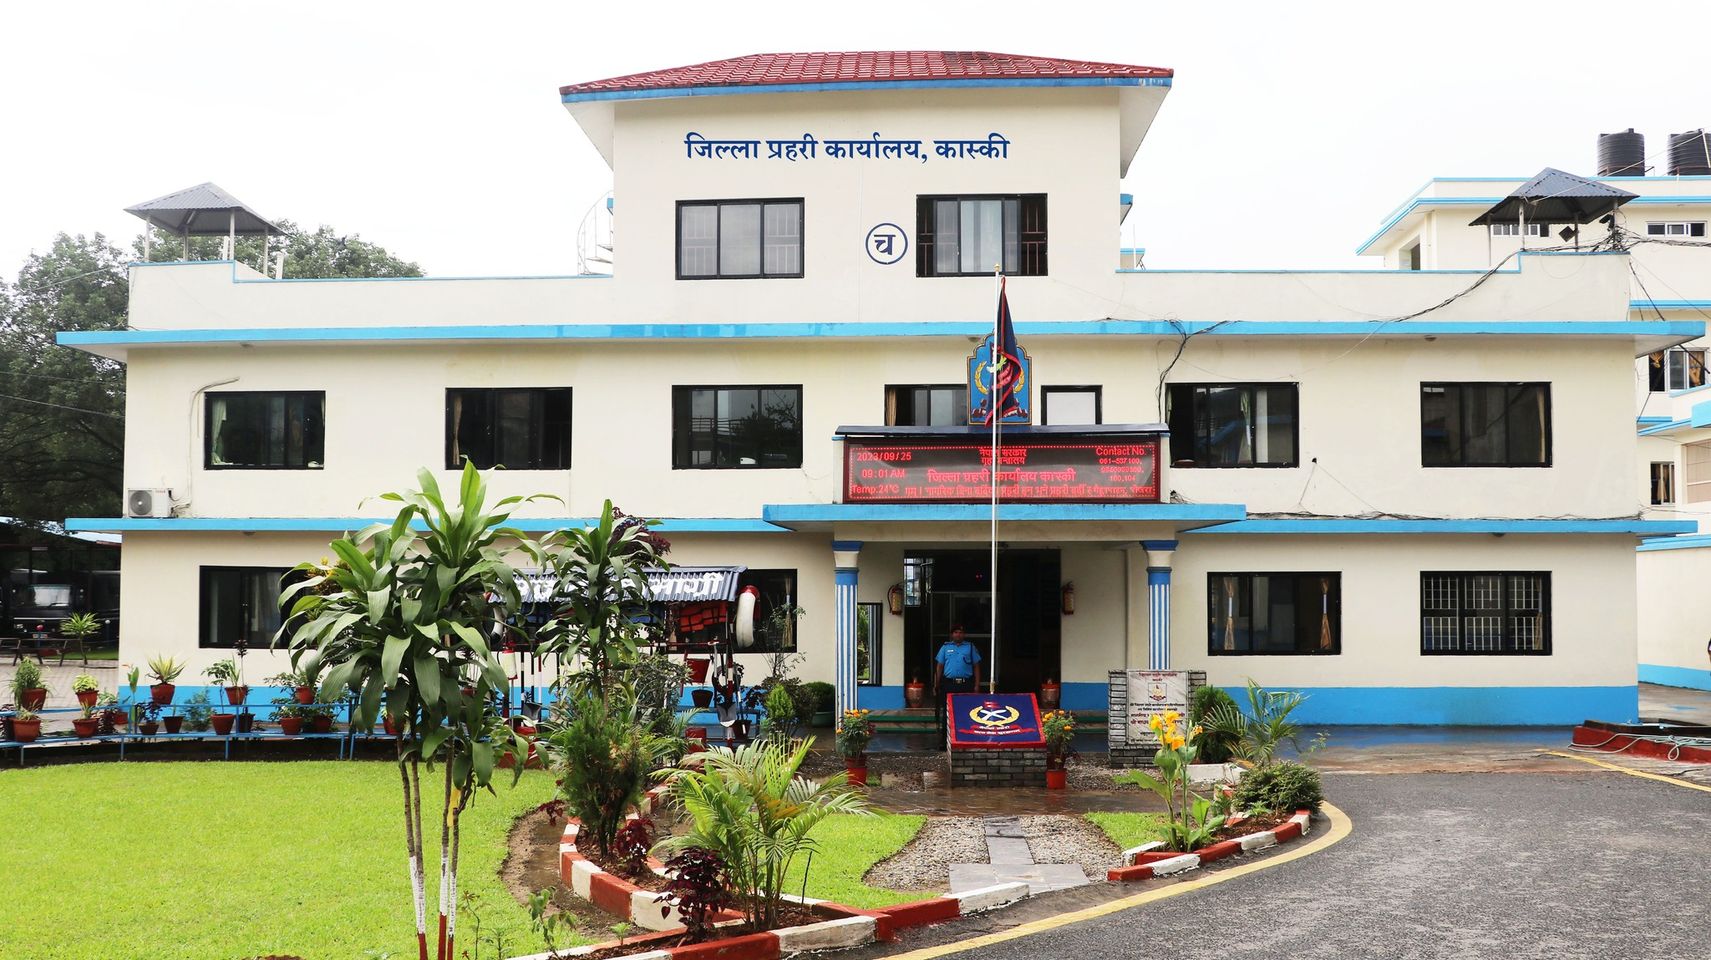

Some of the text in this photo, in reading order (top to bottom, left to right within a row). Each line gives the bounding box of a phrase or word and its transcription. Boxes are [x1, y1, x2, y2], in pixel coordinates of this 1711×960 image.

[684, 131, 1010, 164] जिल्ला प्रहरी कार्यालय, कास्की
[857, 451, 912, 461] 2023/09/25
[1095, 446, 1131, 456] Contact
[927, 467, 961, 483] जिल्ला
[962, 467, 991, 483] प्रहरी
[1038, 467, 1077, 482] कास्की
